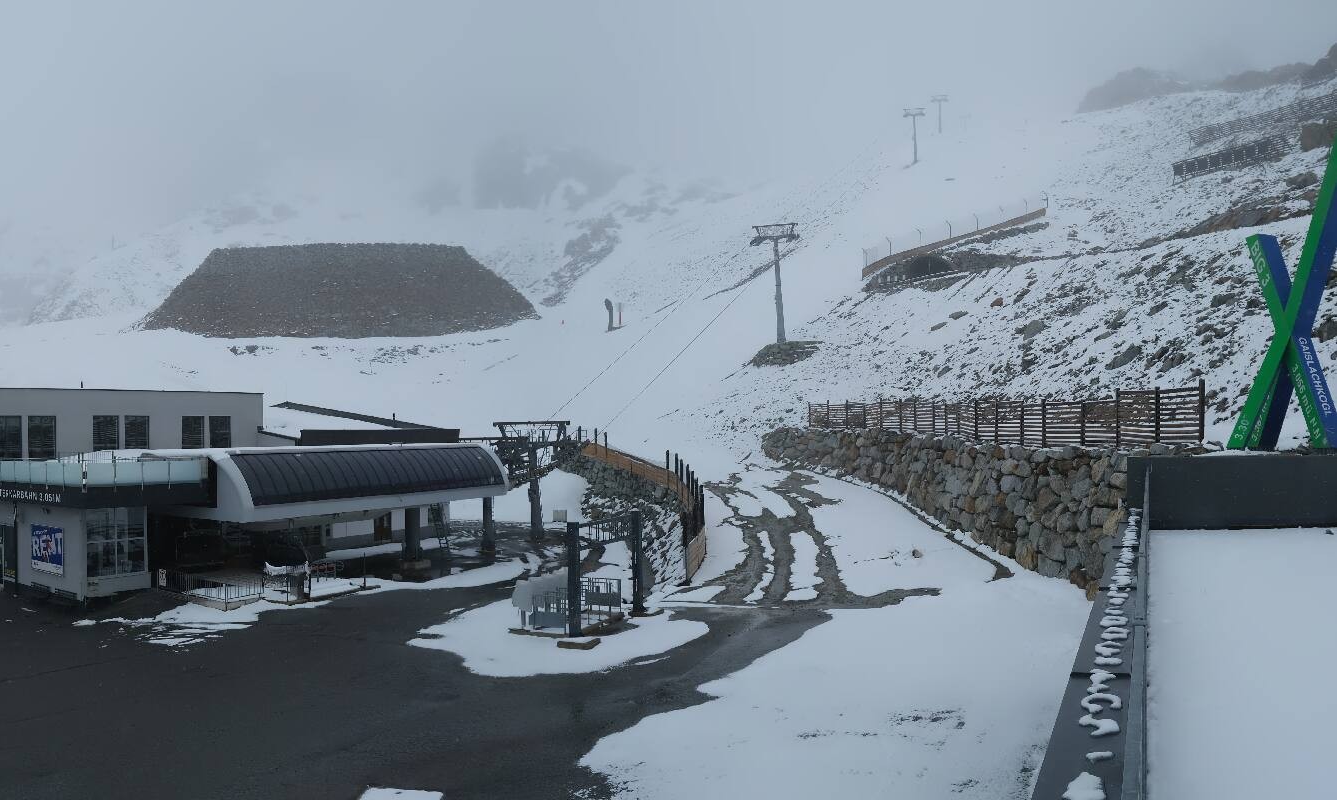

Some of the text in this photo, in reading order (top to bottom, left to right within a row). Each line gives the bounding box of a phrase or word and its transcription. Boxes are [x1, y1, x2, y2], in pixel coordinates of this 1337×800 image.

[1251, 239, 1271, 287] BIG 3
[32, 532, 63, 557] RENT
